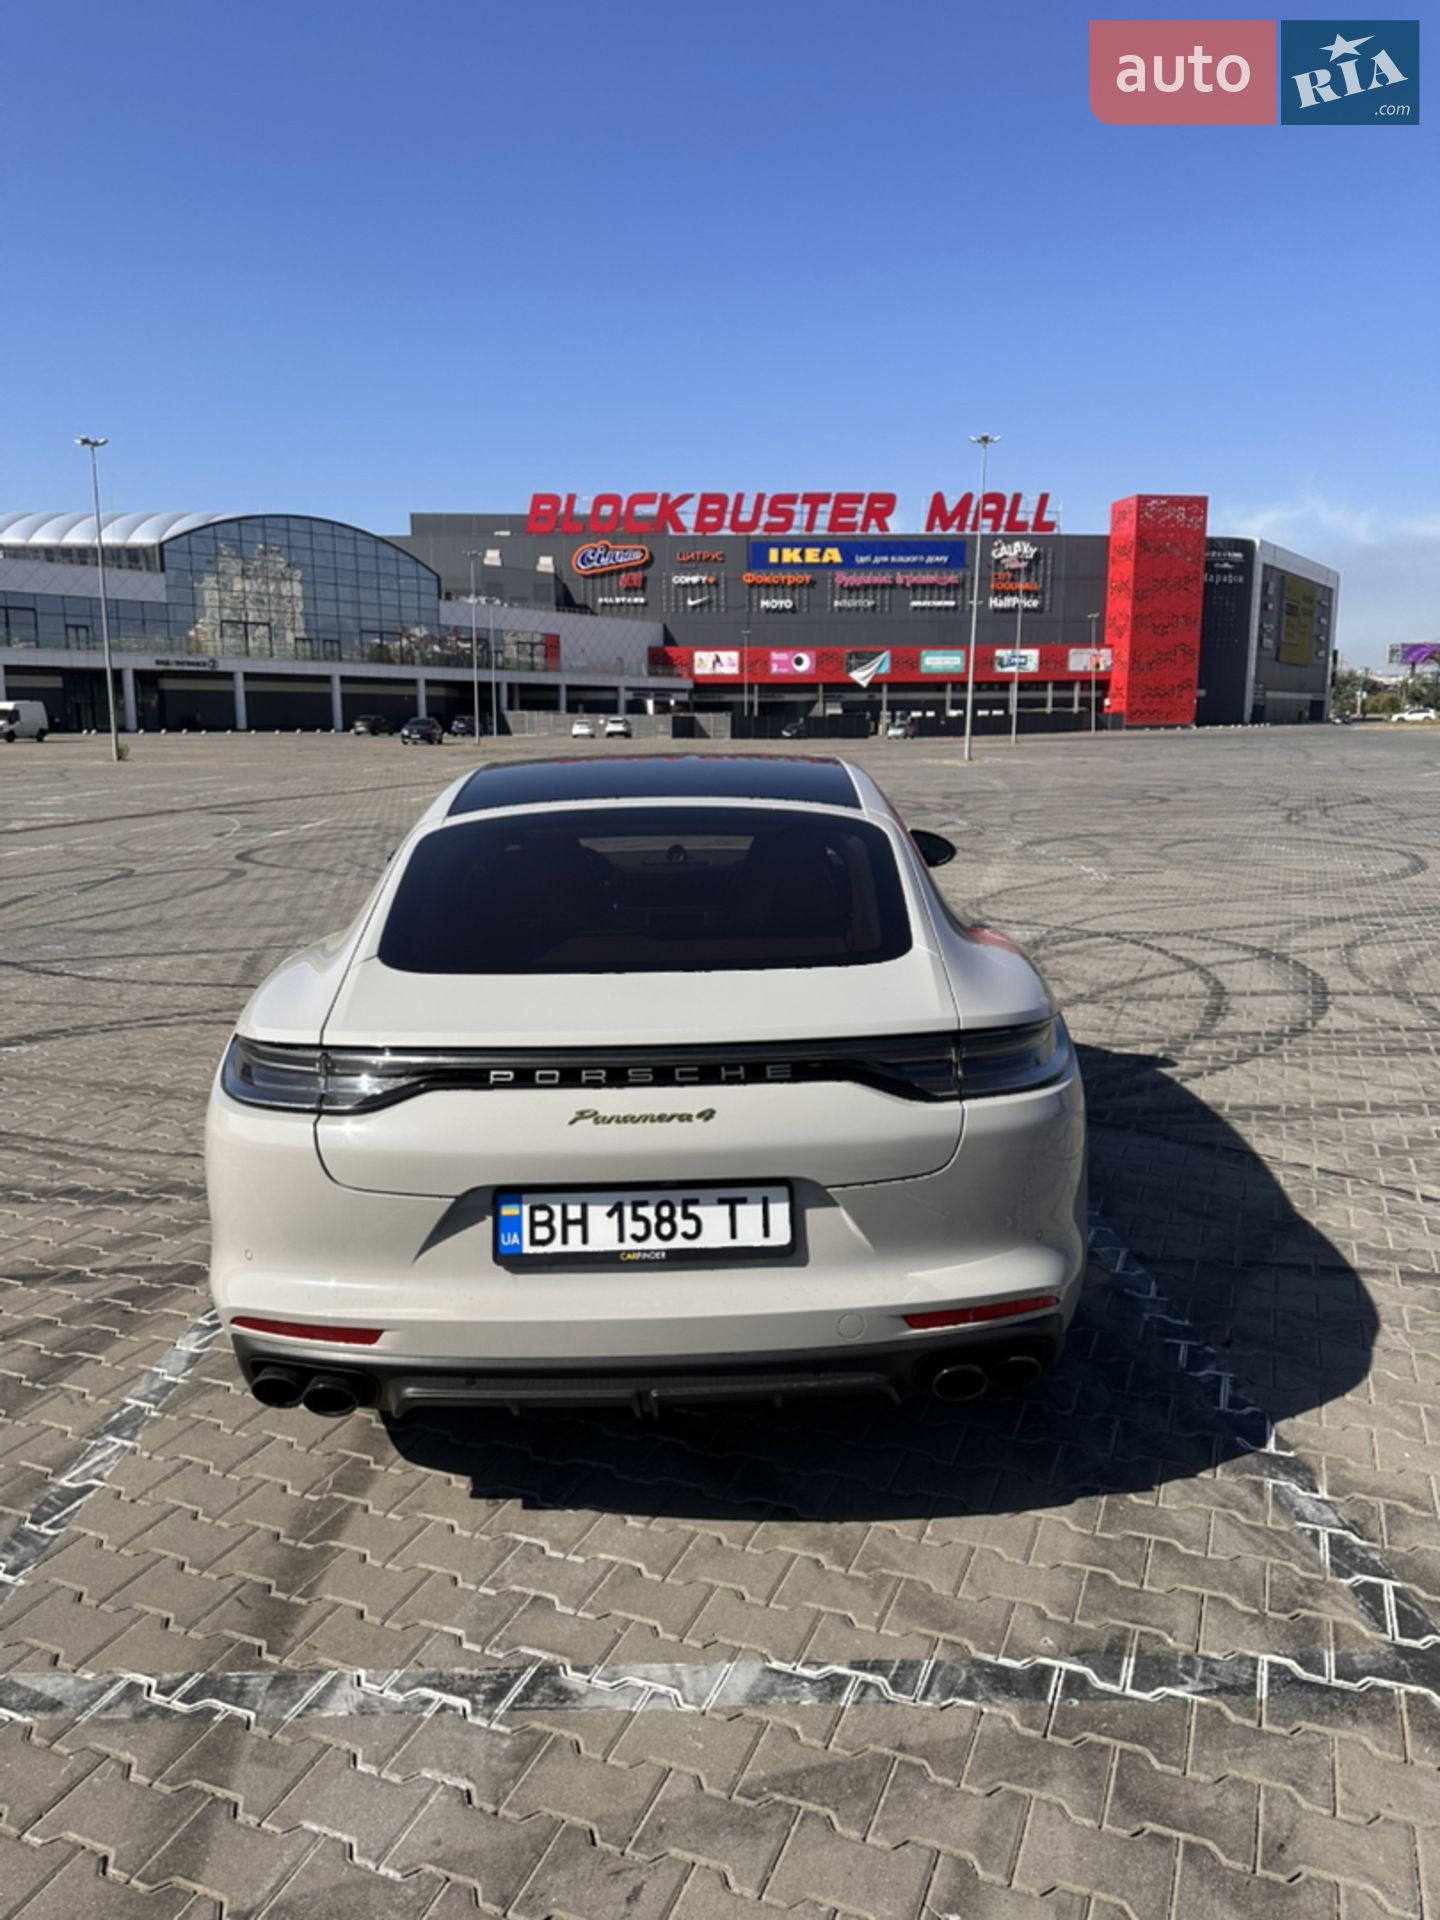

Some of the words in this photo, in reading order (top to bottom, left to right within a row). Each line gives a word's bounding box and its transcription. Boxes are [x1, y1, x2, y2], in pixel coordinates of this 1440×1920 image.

[526, 493, 897, 534] BLOCKBUSTER
[925, 492, 1057, 533] MALL
[676, 551, 724, 562] ЦИТРУС
[768, 547, 843, 564] IKEA
[742, 572, 812, 585] Фокстрот
[989, 596, 1039, 609] HalfPrice
[490, 1065, 793, 1085] PORSCHE
[569, 1109, 694, 1125] Panamera
[695, 1107, 716, 1122] 4
[501, 1233, 520, 1245] UA
[528, 1203, 589, 1247] BH
[606, 1199, 702, 1244] 1585
